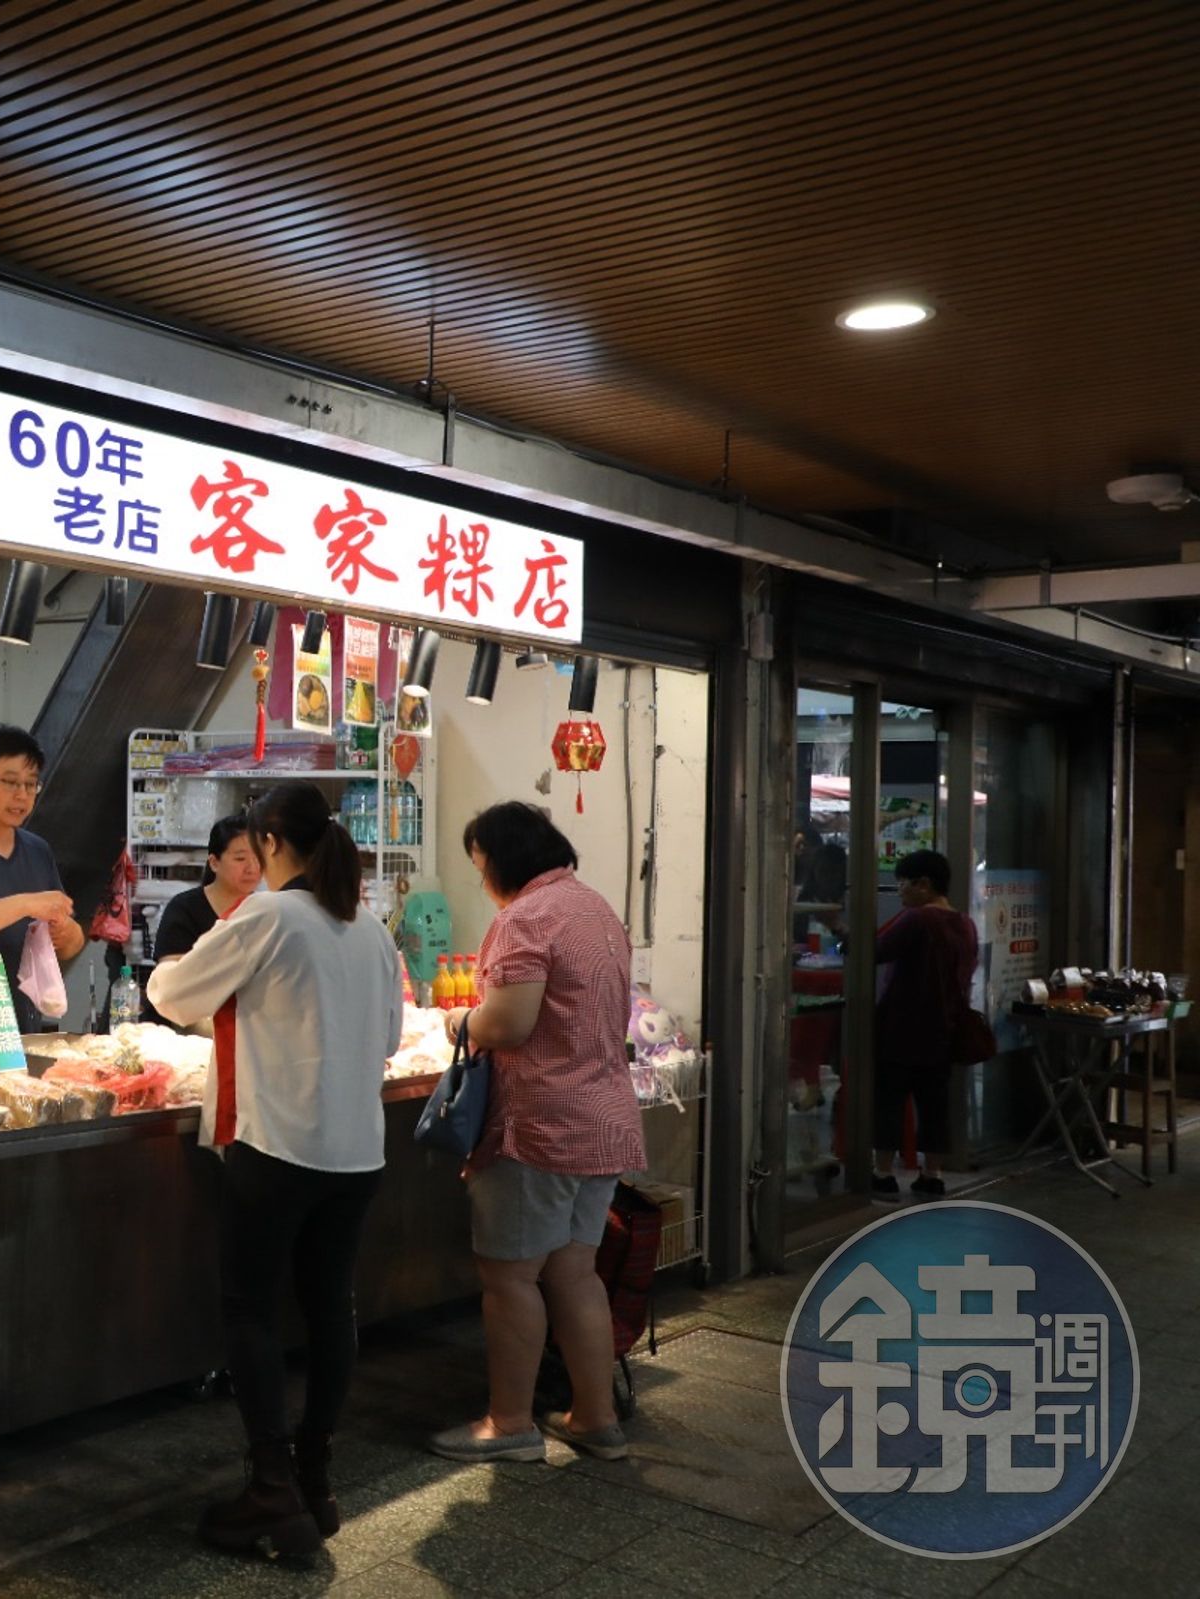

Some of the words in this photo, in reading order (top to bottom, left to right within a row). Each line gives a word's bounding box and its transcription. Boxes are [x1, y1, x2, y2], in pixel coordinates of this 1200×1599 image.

[8, 409, 144, 486] 60年
[53, 486, 162, 554] 老店
[190, 460, 570, 629] 客家粿店
